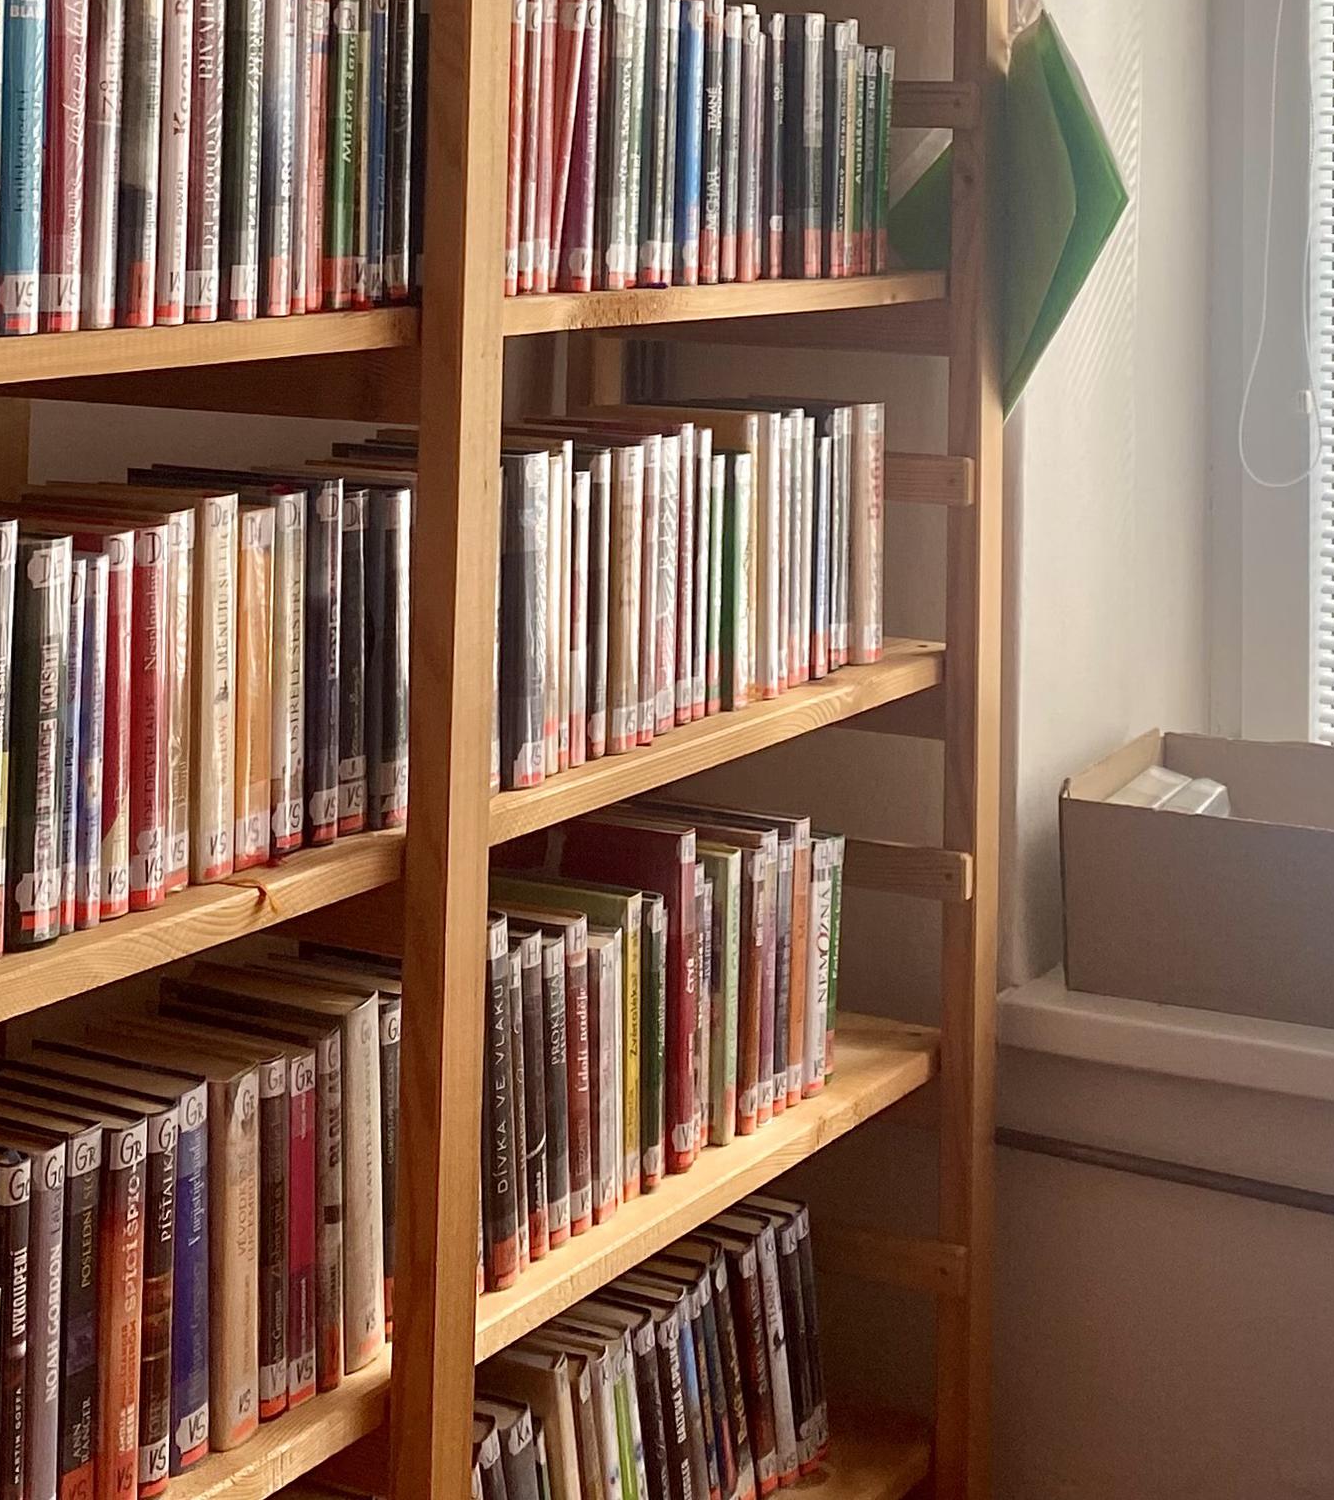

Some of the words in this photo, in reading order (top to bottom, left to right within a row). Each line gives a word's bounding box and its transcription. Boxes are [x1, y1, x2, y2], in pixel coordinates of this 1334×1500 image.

[493, 983, 507, 1065] VLAKU
[495, 1073, 508, 1108] VE
[495, 1121, 509, 1195] DÍVKA
[46, 1244, 64, 1334] GORDON
[120, 1239, 141, 1315] SPÍCÍ
[44, 1336, 61, 1404] NOAH
